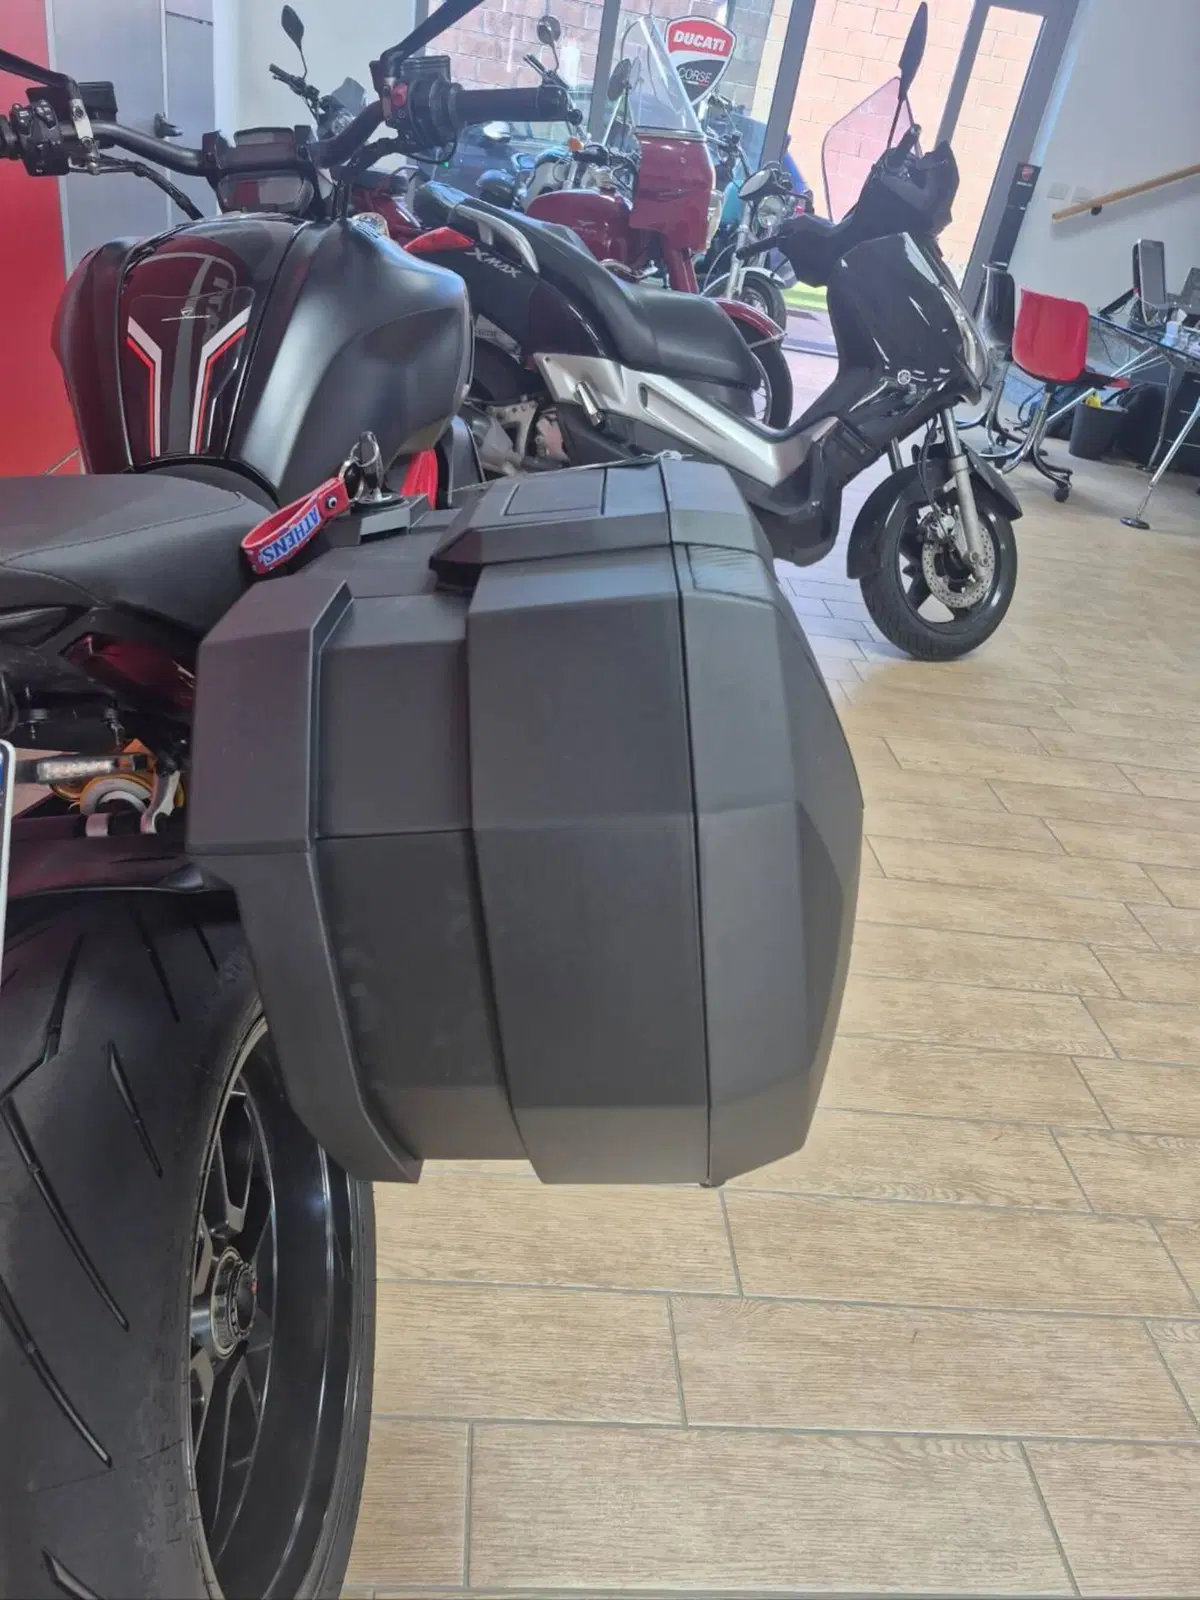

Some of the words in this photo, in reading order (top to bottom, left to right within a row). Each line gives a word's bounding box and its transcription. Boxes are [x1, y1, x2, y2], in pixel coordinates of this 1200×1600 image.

[673, 30, 727, 52] DUCATI
[678, 67, 713, 83] CORSE
[262, 507, 321, 564] ATHENS
